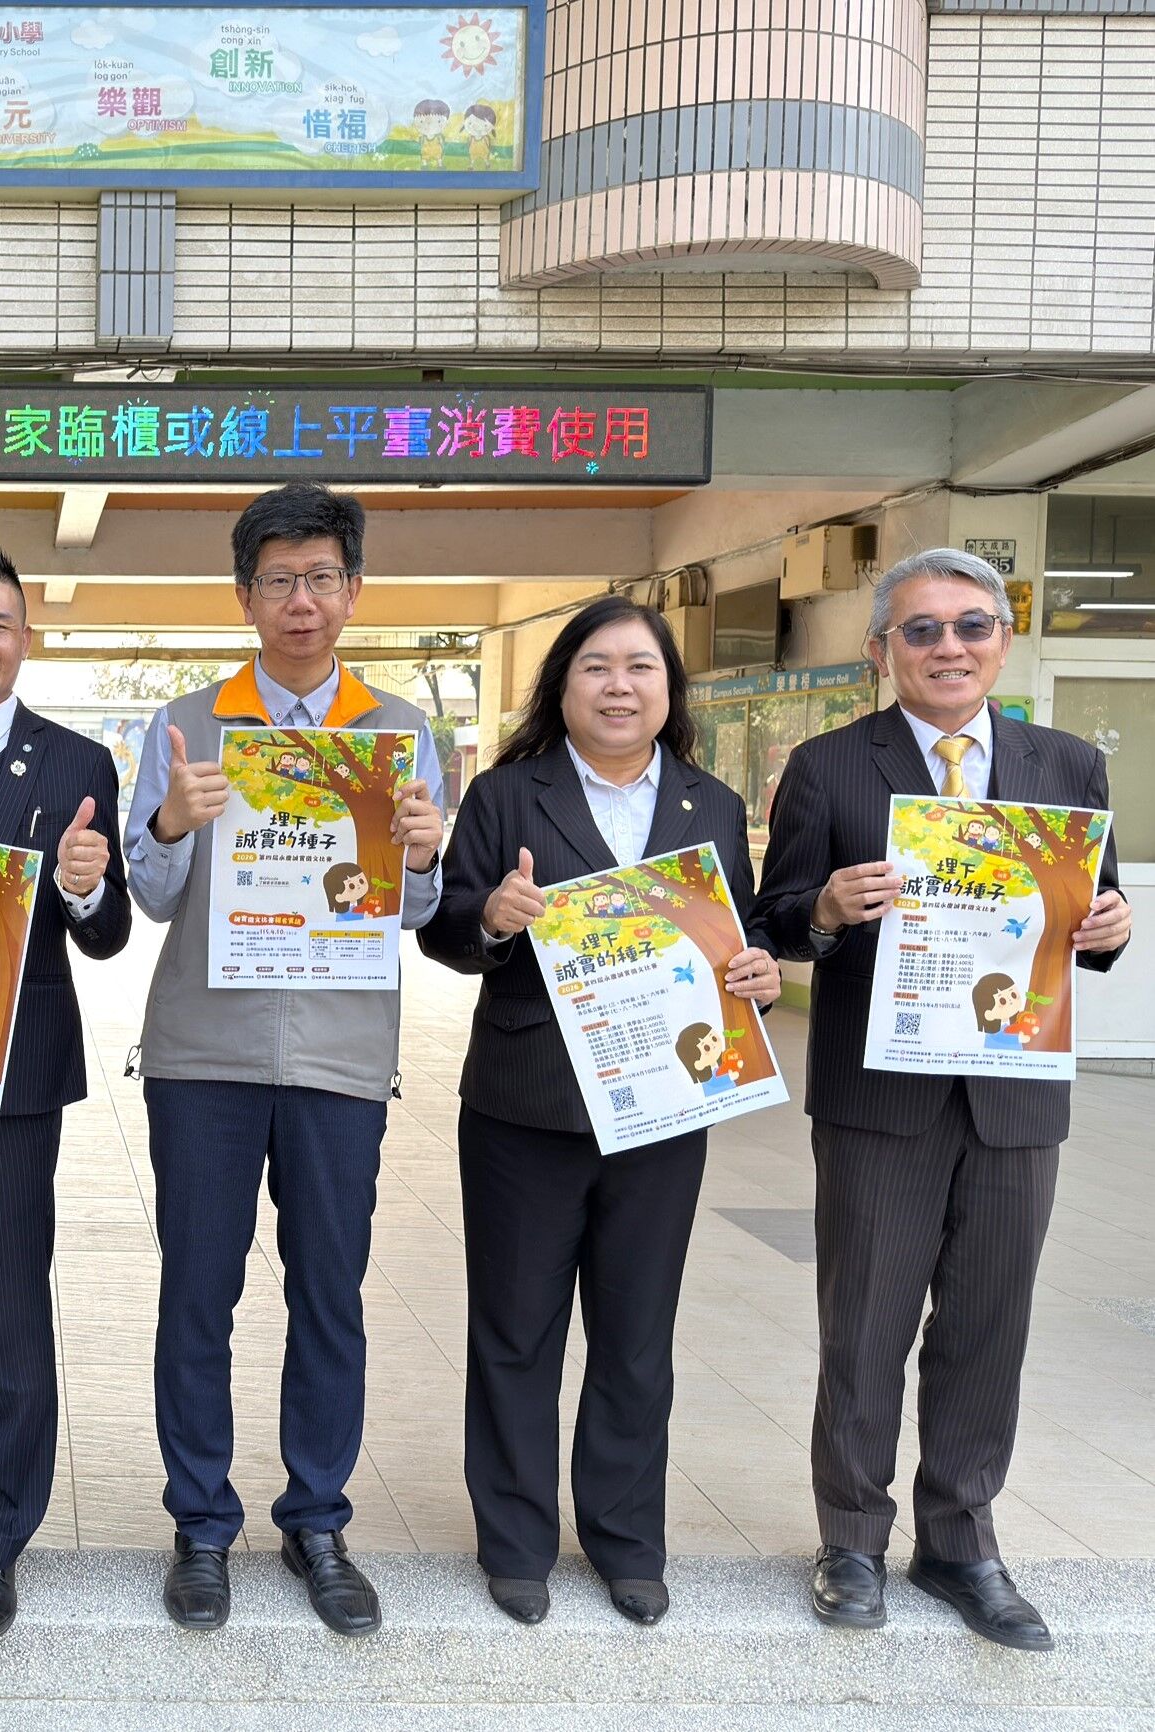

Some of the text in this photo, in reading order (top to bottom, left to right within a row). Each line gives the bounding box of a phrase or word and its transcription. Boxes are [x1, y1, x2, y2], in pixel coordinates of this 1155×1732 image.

[10, 48, 40, 56] School
[209, 48, 274, 79] 創新
[228, 81, 303, 94] INNOVATION
[97, 86, 162, 118] 樂觀
[127, 119, 188, 132] OPTIMISM
[302, 109, 367, 140] 惜福
[324, 142, 377, 153] CHERISH
[817, 676, 836, 687] Honor
[270, 812, 307, 830] 埋下
[235, 828, 337, 850] 誠實的種子
[936, 858, 976, 878] 埋下
[580, 932, 618, 950] 埋下
[554, 941, 656, 982] 誠實的種子
